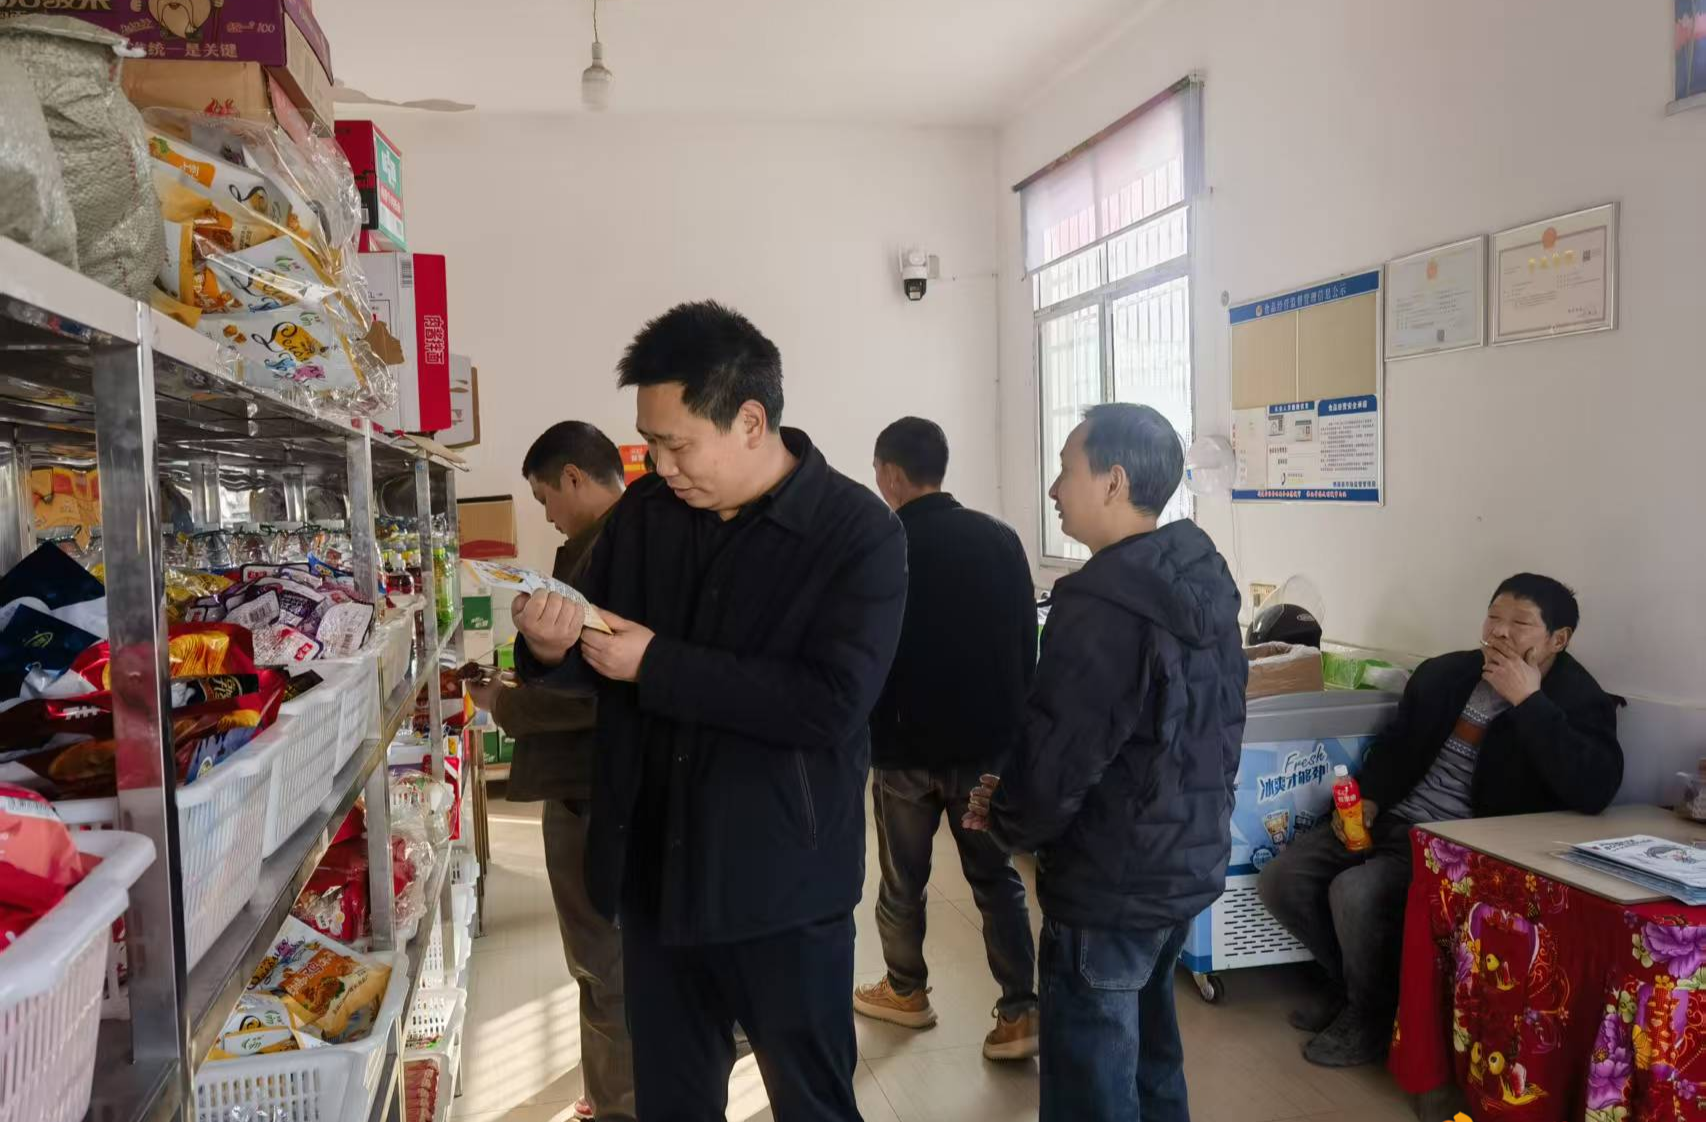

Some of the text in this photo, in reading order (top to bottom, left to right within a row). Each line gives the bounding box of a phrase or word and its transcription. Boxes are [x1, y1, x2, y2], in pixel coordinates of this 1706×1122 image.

[257, 22, 275, 33] 100
[424, 315, 445, 365] 肉酱拌面
[1284, 744, 1325, 773] Fresh
